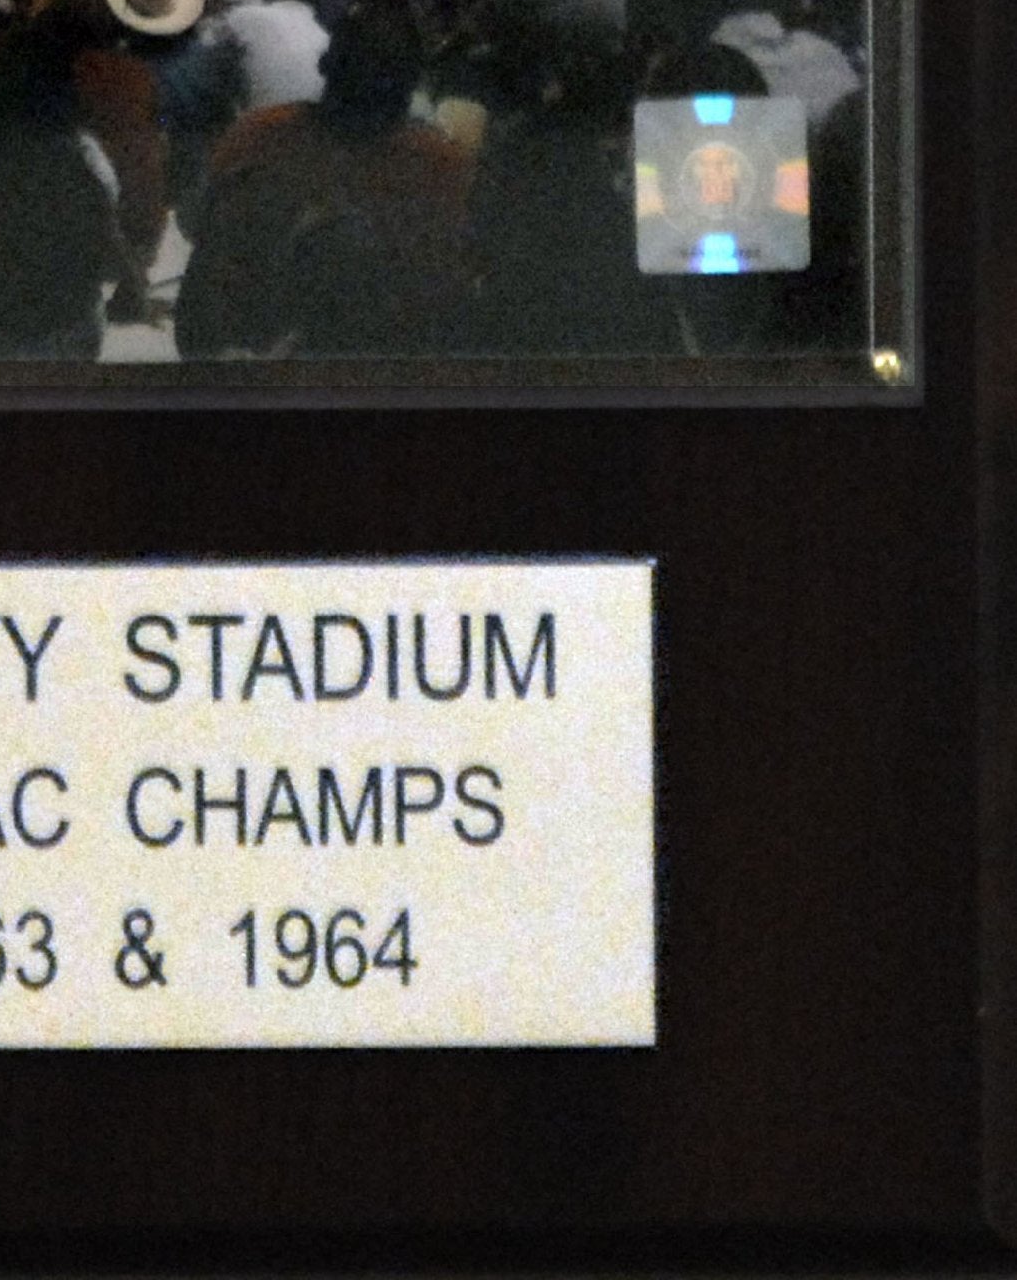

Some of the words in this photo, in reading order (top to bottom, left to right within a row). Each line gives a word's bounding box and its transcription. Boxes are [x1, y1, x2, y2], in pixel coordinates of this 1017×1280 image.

[123, 612, 556, 704] STADIUM
[125, 764, 505, 848] CHAMPS
[114, 908, 167, 990] &
[230, 908, 418, 989] 1964
